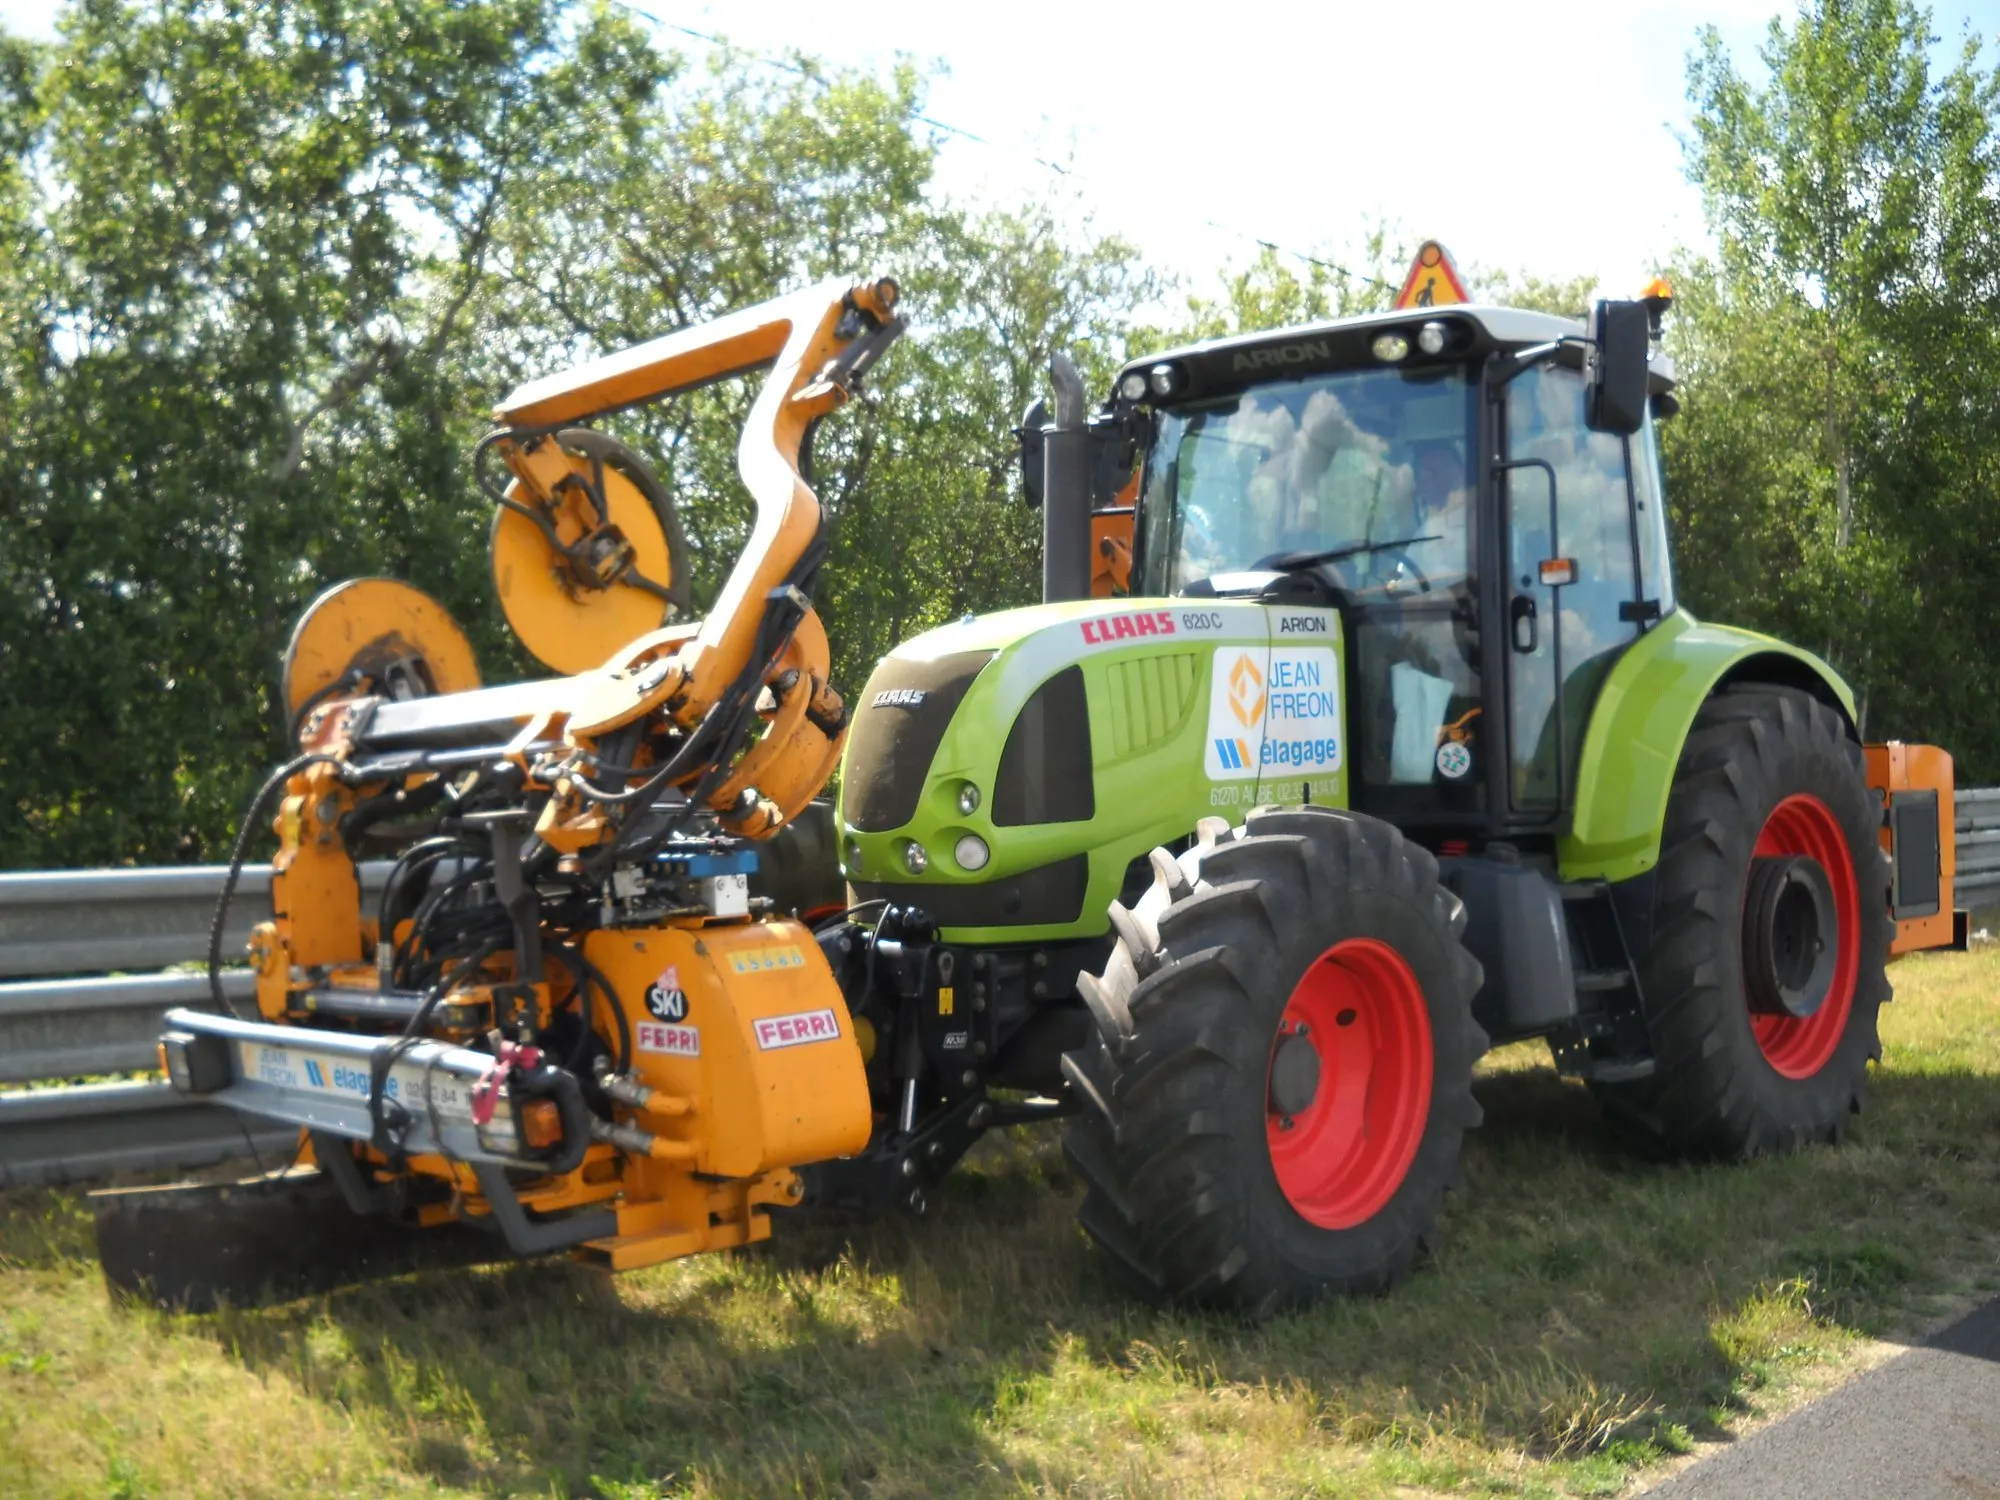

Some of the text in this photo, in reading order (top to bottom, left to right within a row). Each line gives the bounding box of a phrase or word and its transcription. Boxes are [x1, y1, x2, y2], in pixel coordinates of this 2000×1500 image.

[1233, 341, 1330, 371] ARION
[1080, 612, 1222, 644] CLAAS 620C
[1280, 616, 1327, 633] ARION
[1269, 661, 1320, 689] JEAN
[1270, 691, 1335, 719] FREON
[1260, 737, 1337, 767] élagage
[650, 988, 683, 1017] SKI
[640, 1025, 698, 1052] FERRI
[759, 1014, 836, 1044] FERRI
[333, 1062, 399, 1098] élage
